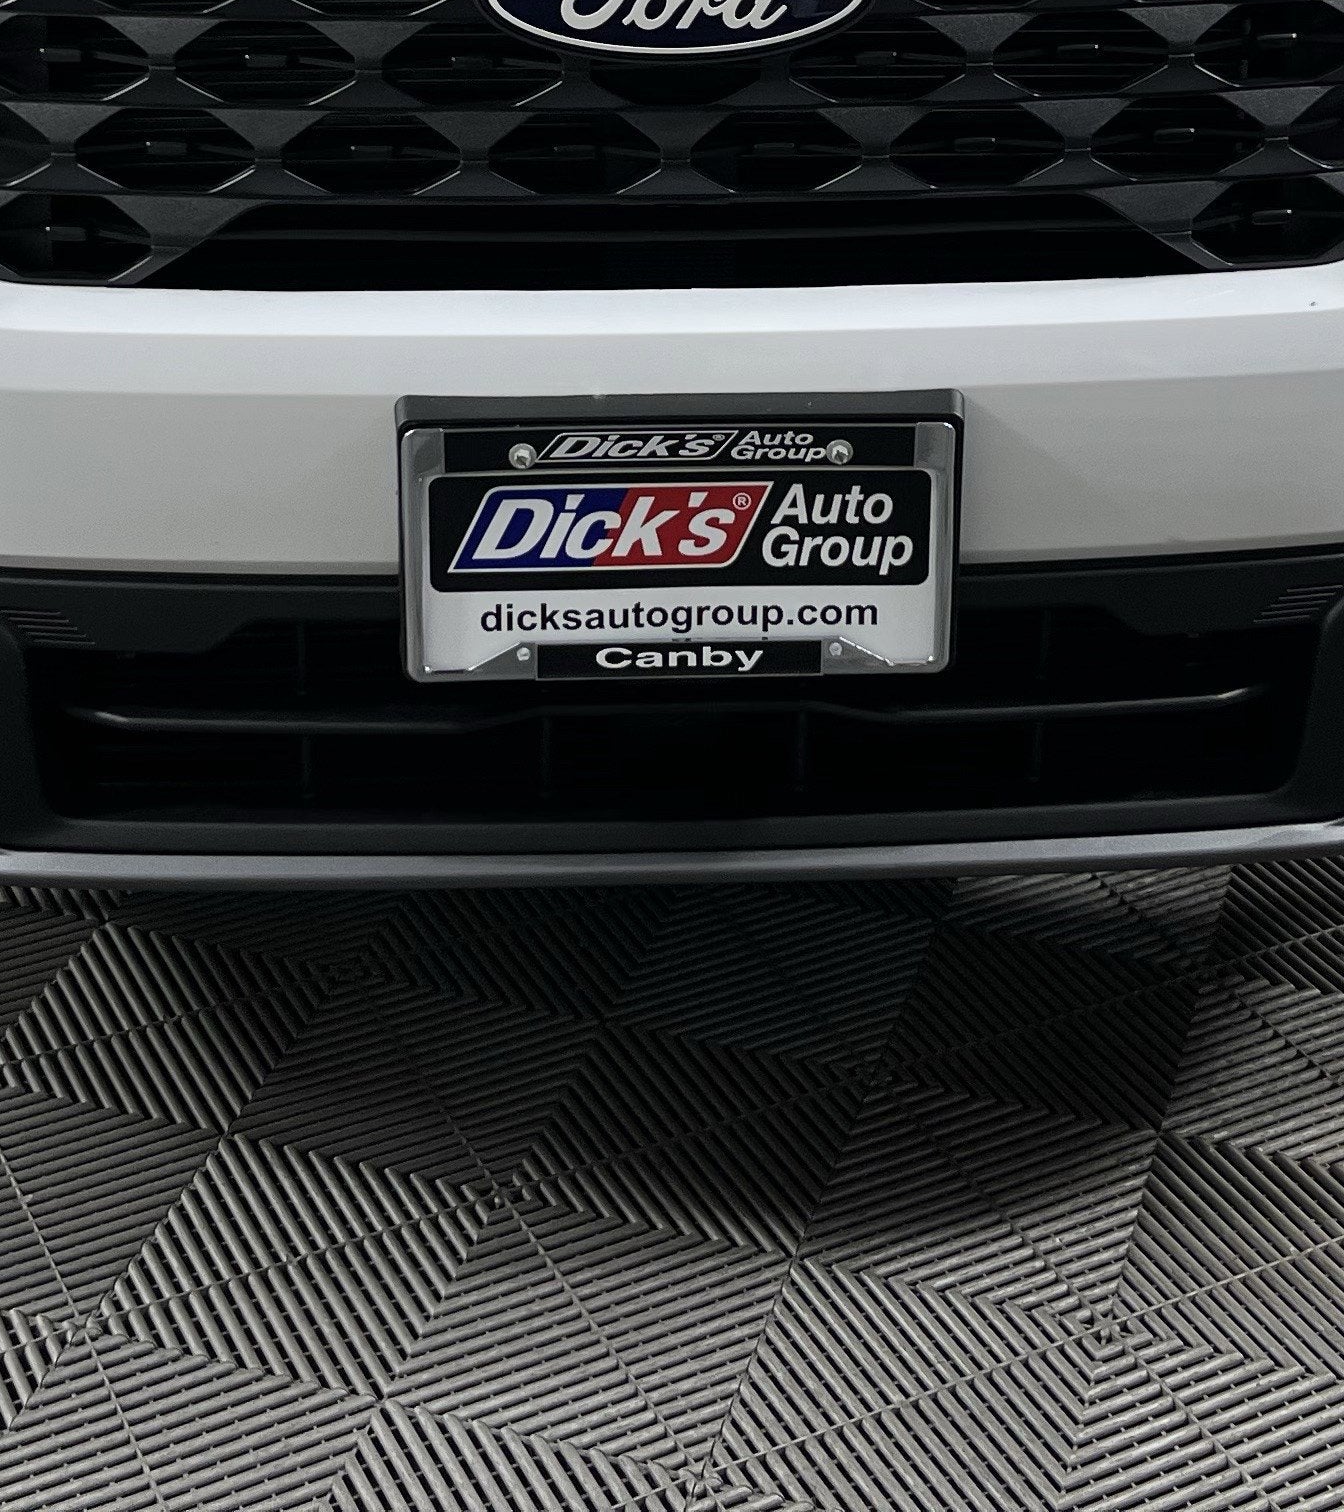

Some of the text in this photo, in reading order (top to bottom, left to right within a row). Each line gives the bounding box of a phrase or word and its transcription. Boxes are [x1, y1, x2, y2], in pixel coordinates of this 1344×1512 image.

[738, 430, 814, 445] Auto
[730, 445, 827, 462] Group
[770, 483, 893, 526] Auto
[761, 528, 914, 576] Group
[480, 601, 879, 633] dicksautogroup.com
[594, 645, 764, 673] Canby
